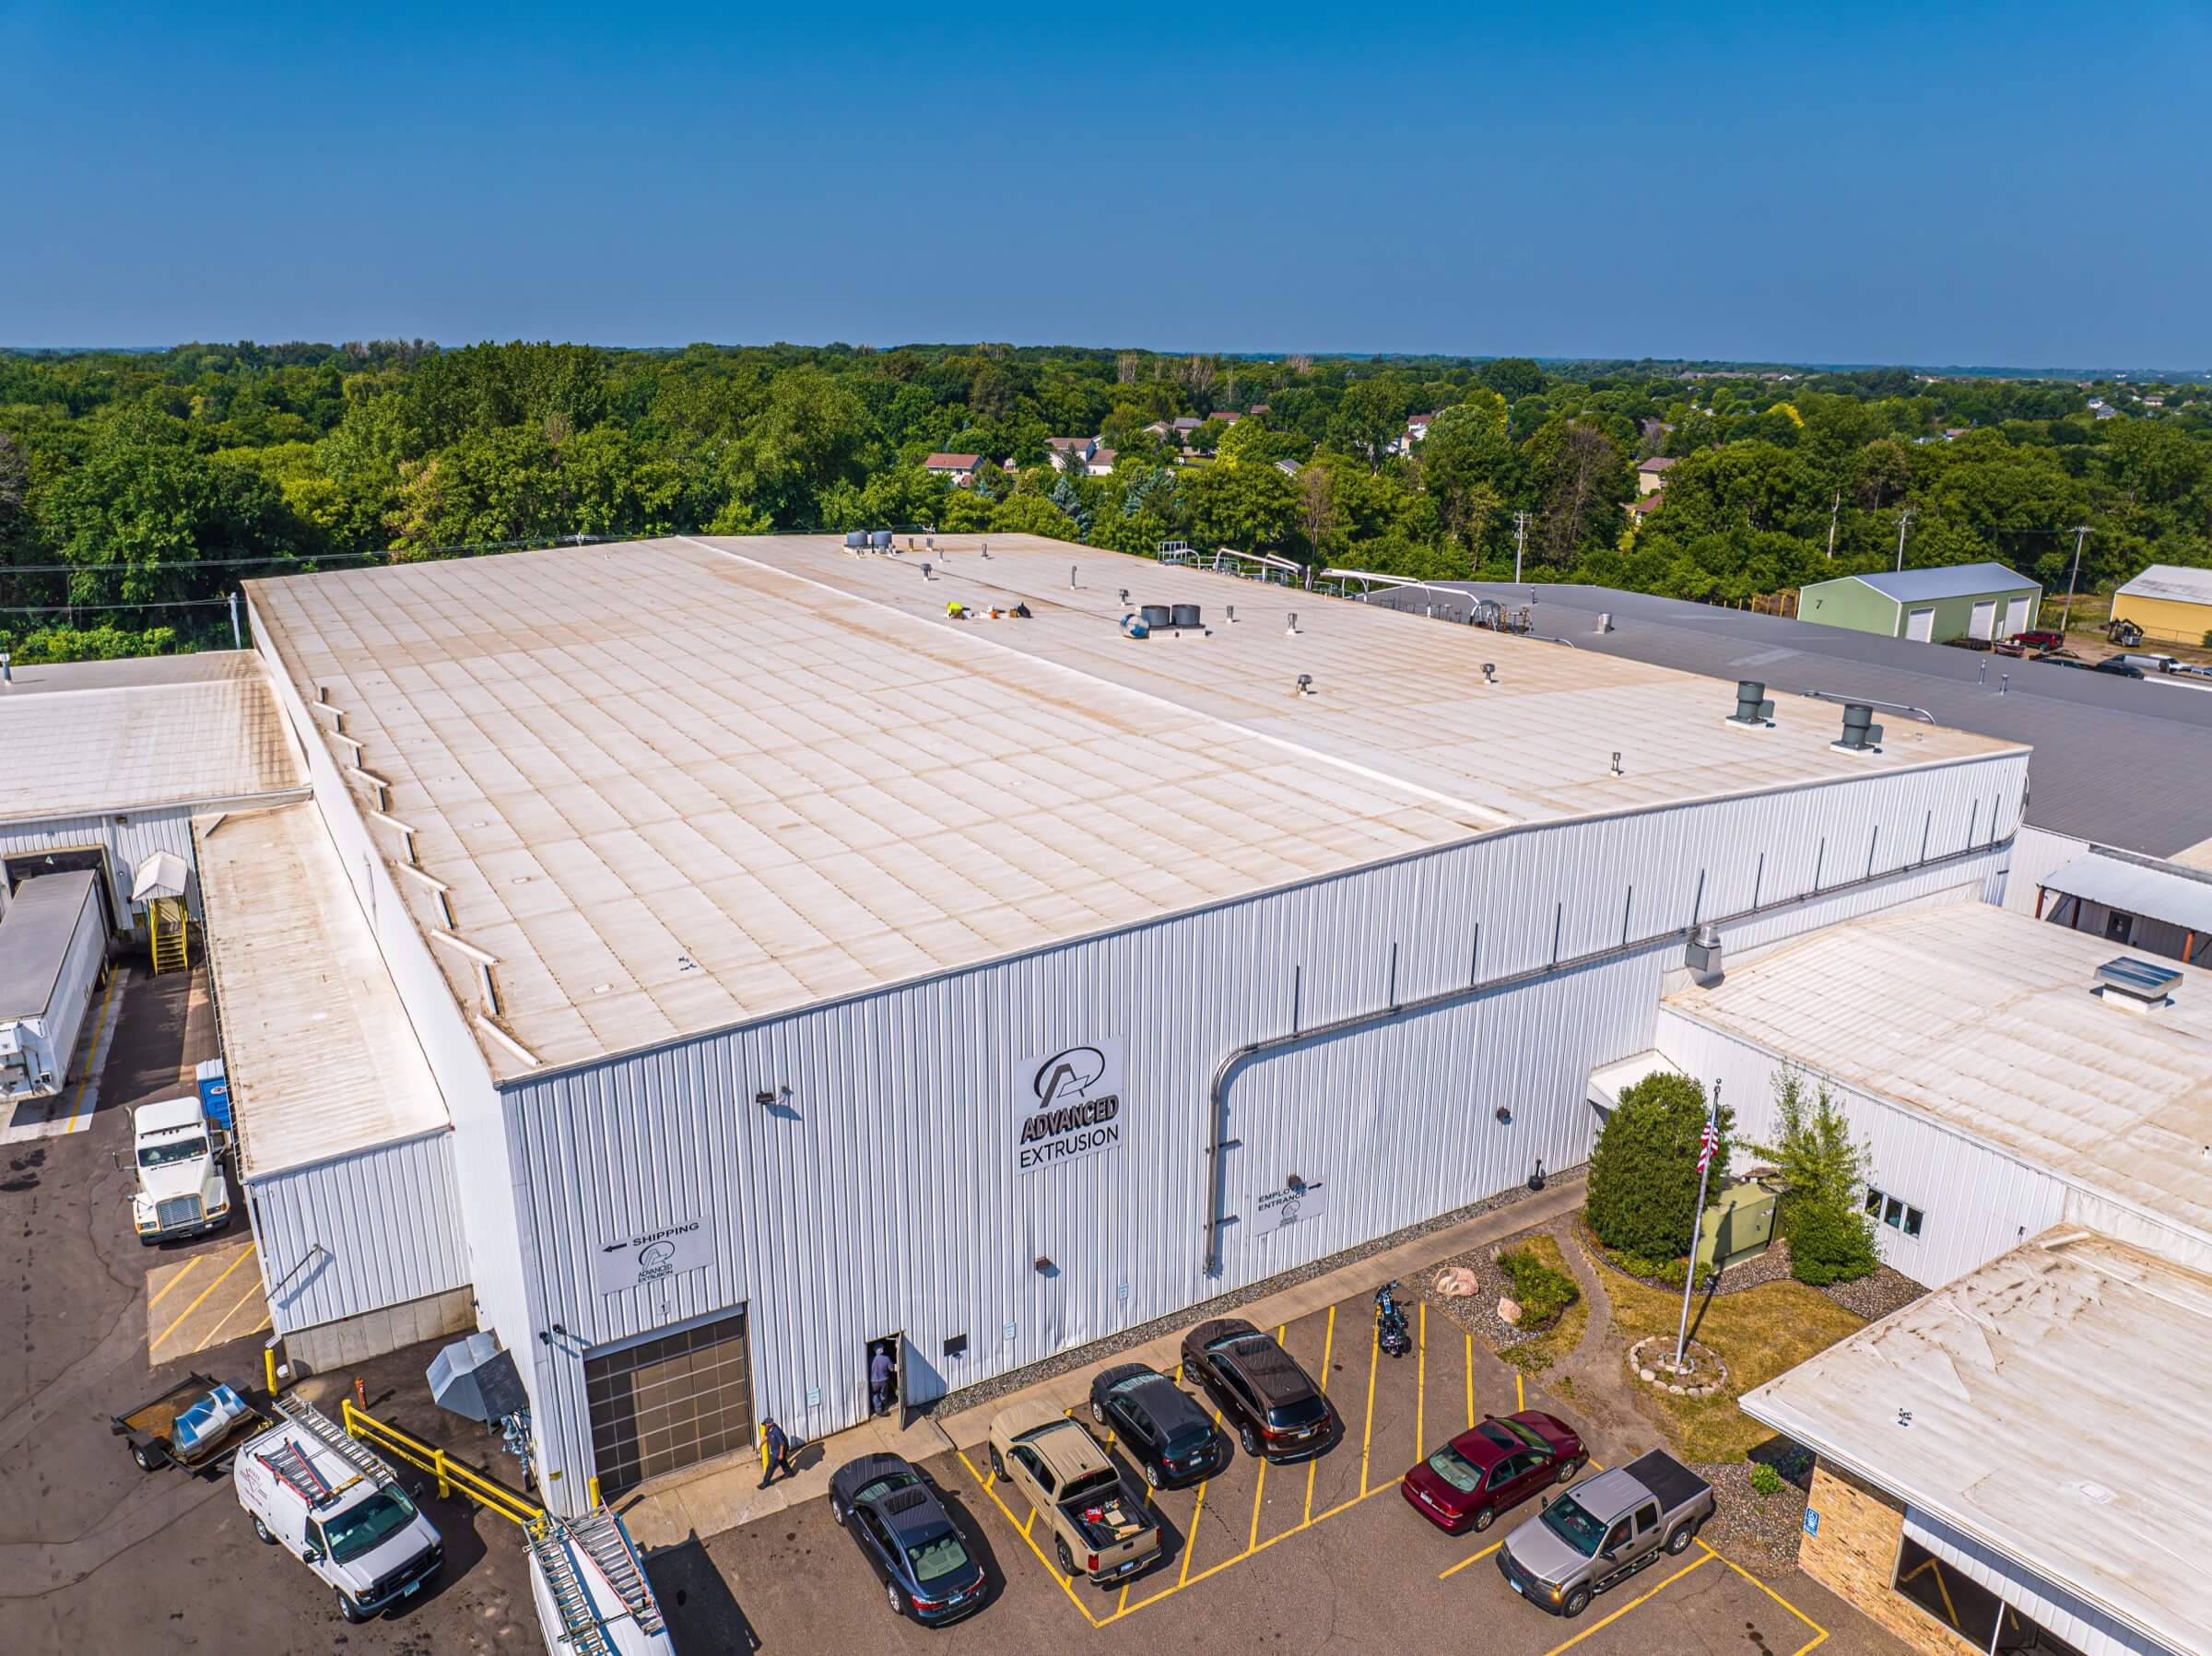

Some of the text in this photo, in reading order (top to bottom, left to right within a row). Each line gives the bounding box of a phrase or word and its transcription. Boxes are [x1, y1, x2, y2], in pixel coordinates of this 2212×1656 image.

[1816, 599, 1823, 610] 7
[1020, 1094, 1120, 1145] ADVANCED
[1020, 1124, 1119, 1169] EXTRUSION
[1258, 1191, 1307, 1212] ENTRANCE
[632, 1222, 700, 1246] SHIPPING
